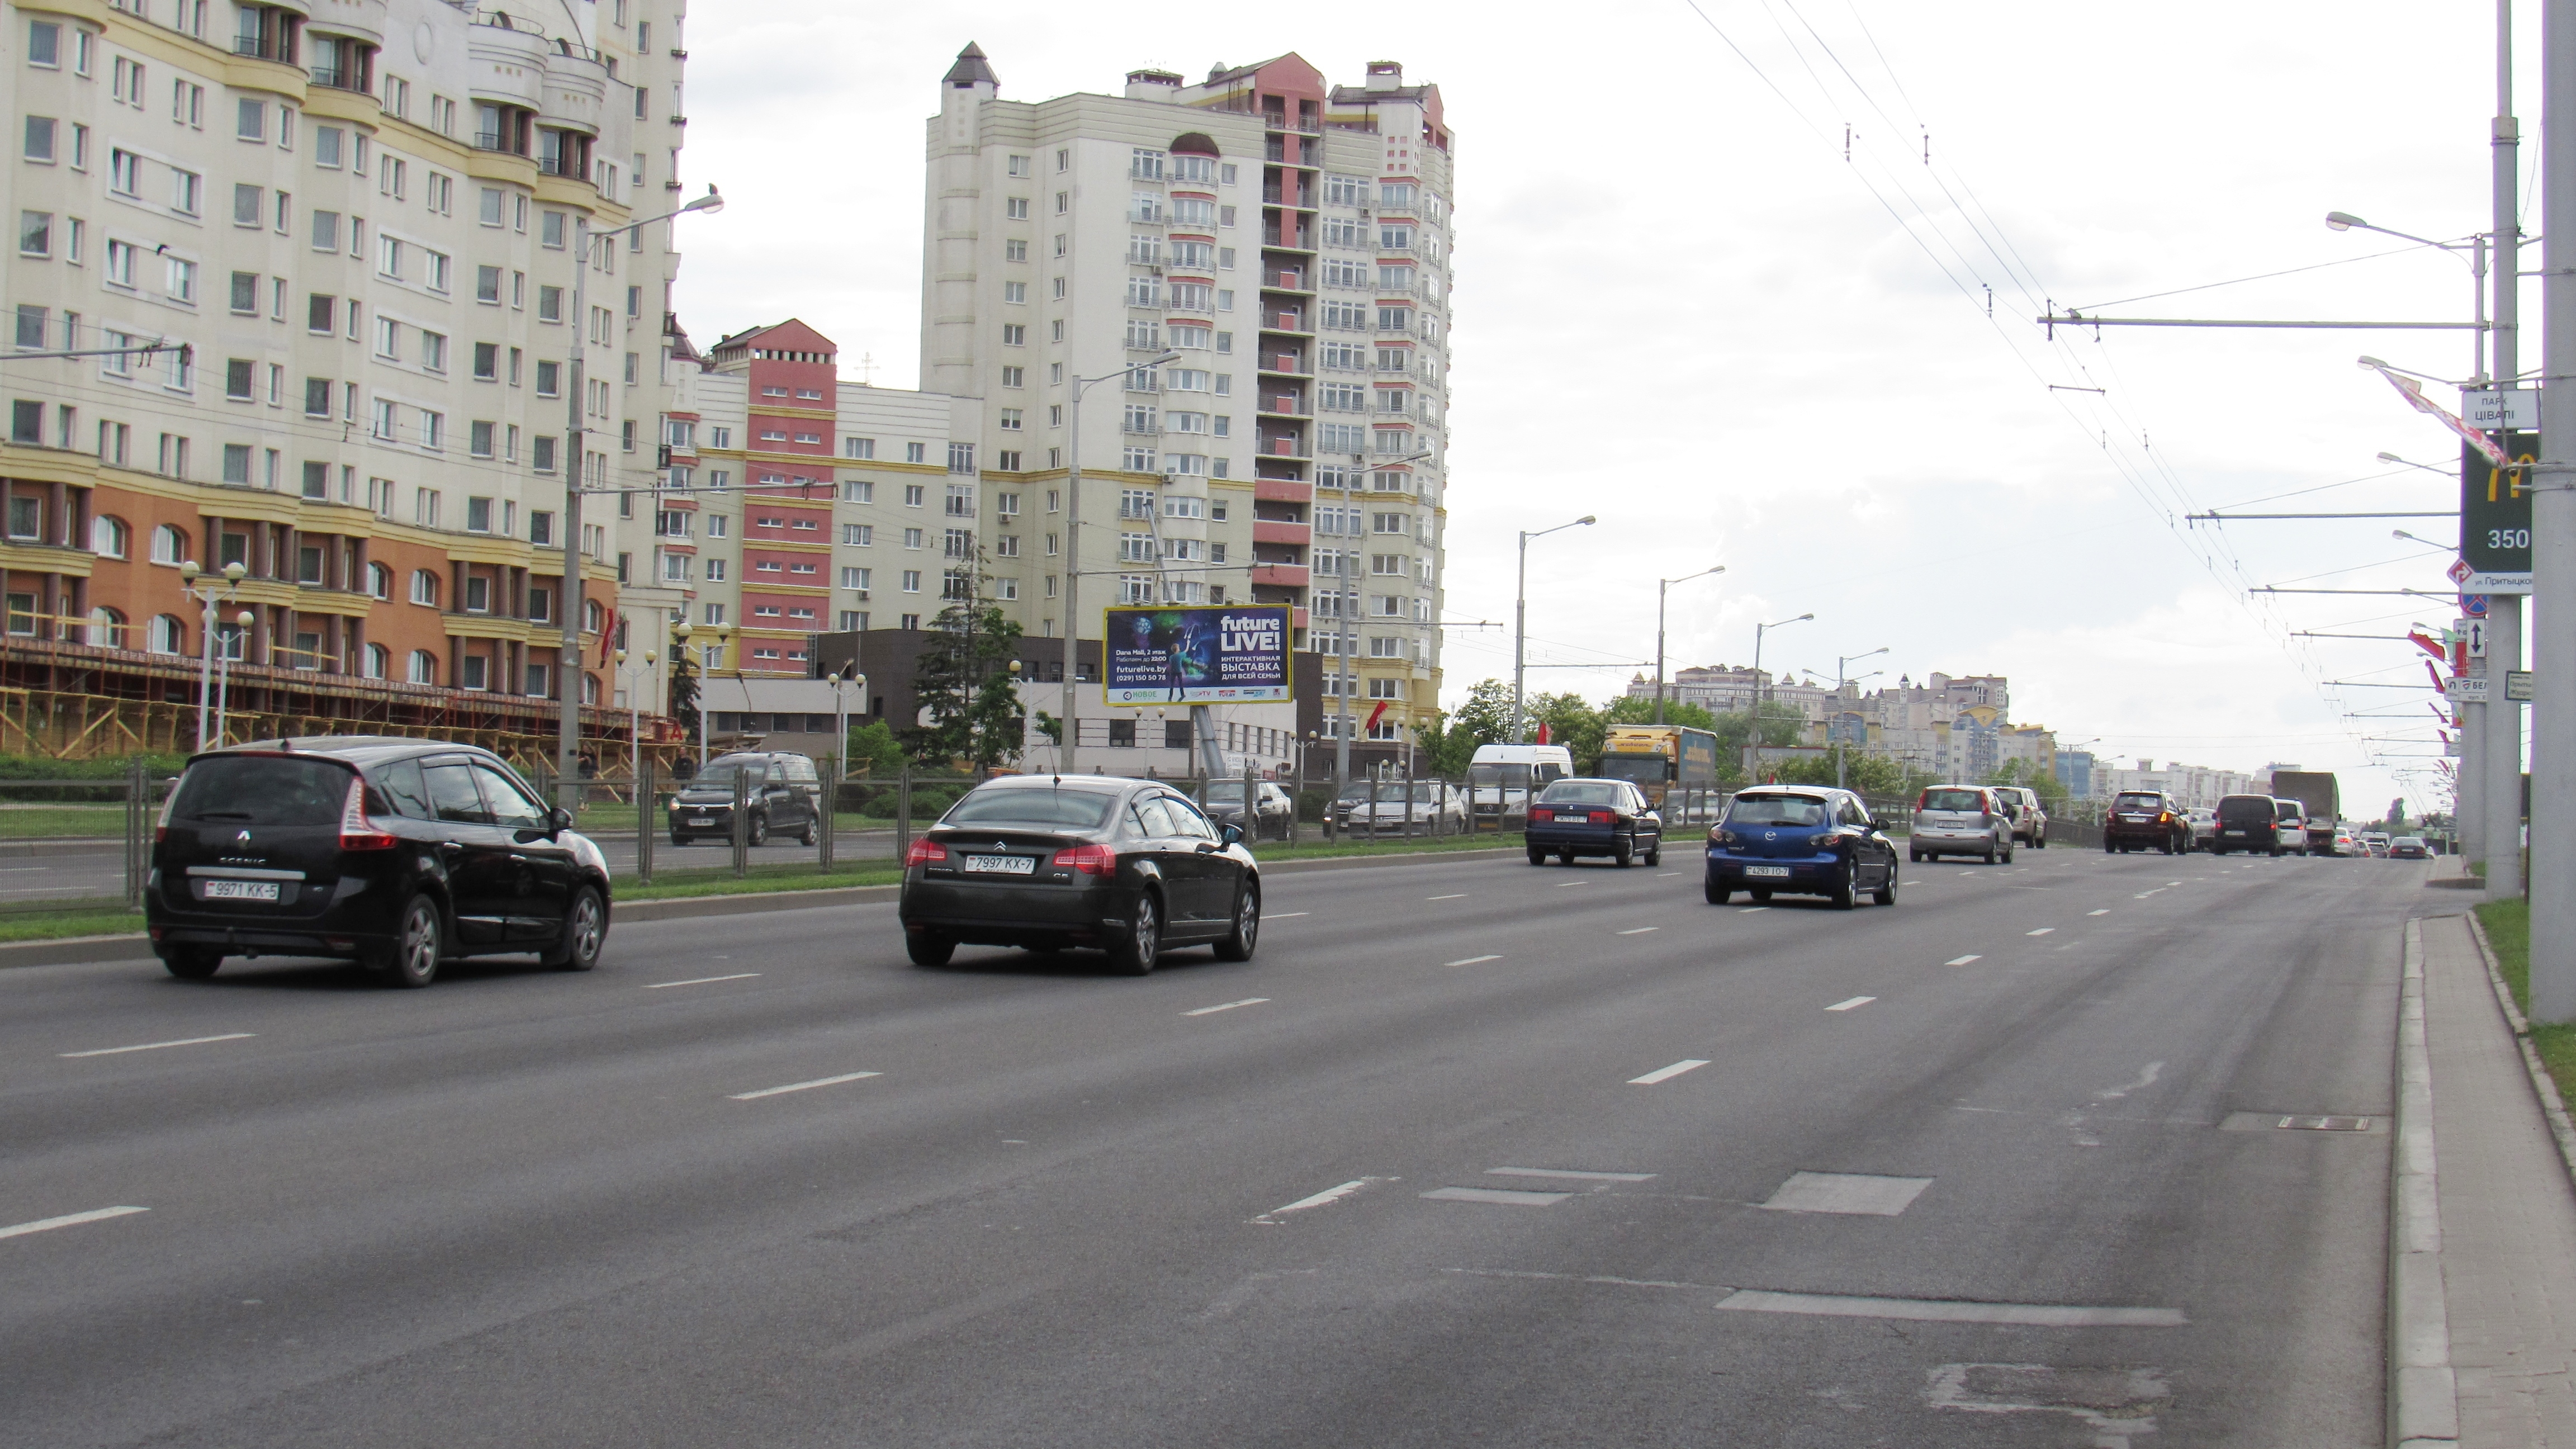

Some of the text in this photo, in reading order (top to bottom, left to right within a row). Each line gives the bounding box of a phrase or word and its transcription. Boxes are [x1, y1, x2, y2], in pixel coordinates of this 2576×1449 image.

[2487, 529, 2529, 549] 350
[2485, 576, 2532, 586] Притыцко
[1220, 615, 1280, 632] future
[1220, 632, 1280, 652] LIVE!
[1116, 665, 1167, 674] futurelive.by
[1221, 662, 1281, 672] ВЫСТАВКА
[977, 857, 1033, 870] 7997 KX-7
[1753, 866, 1769, 875] 4293
[216, 883, 278, 898] 9971 KK-5
